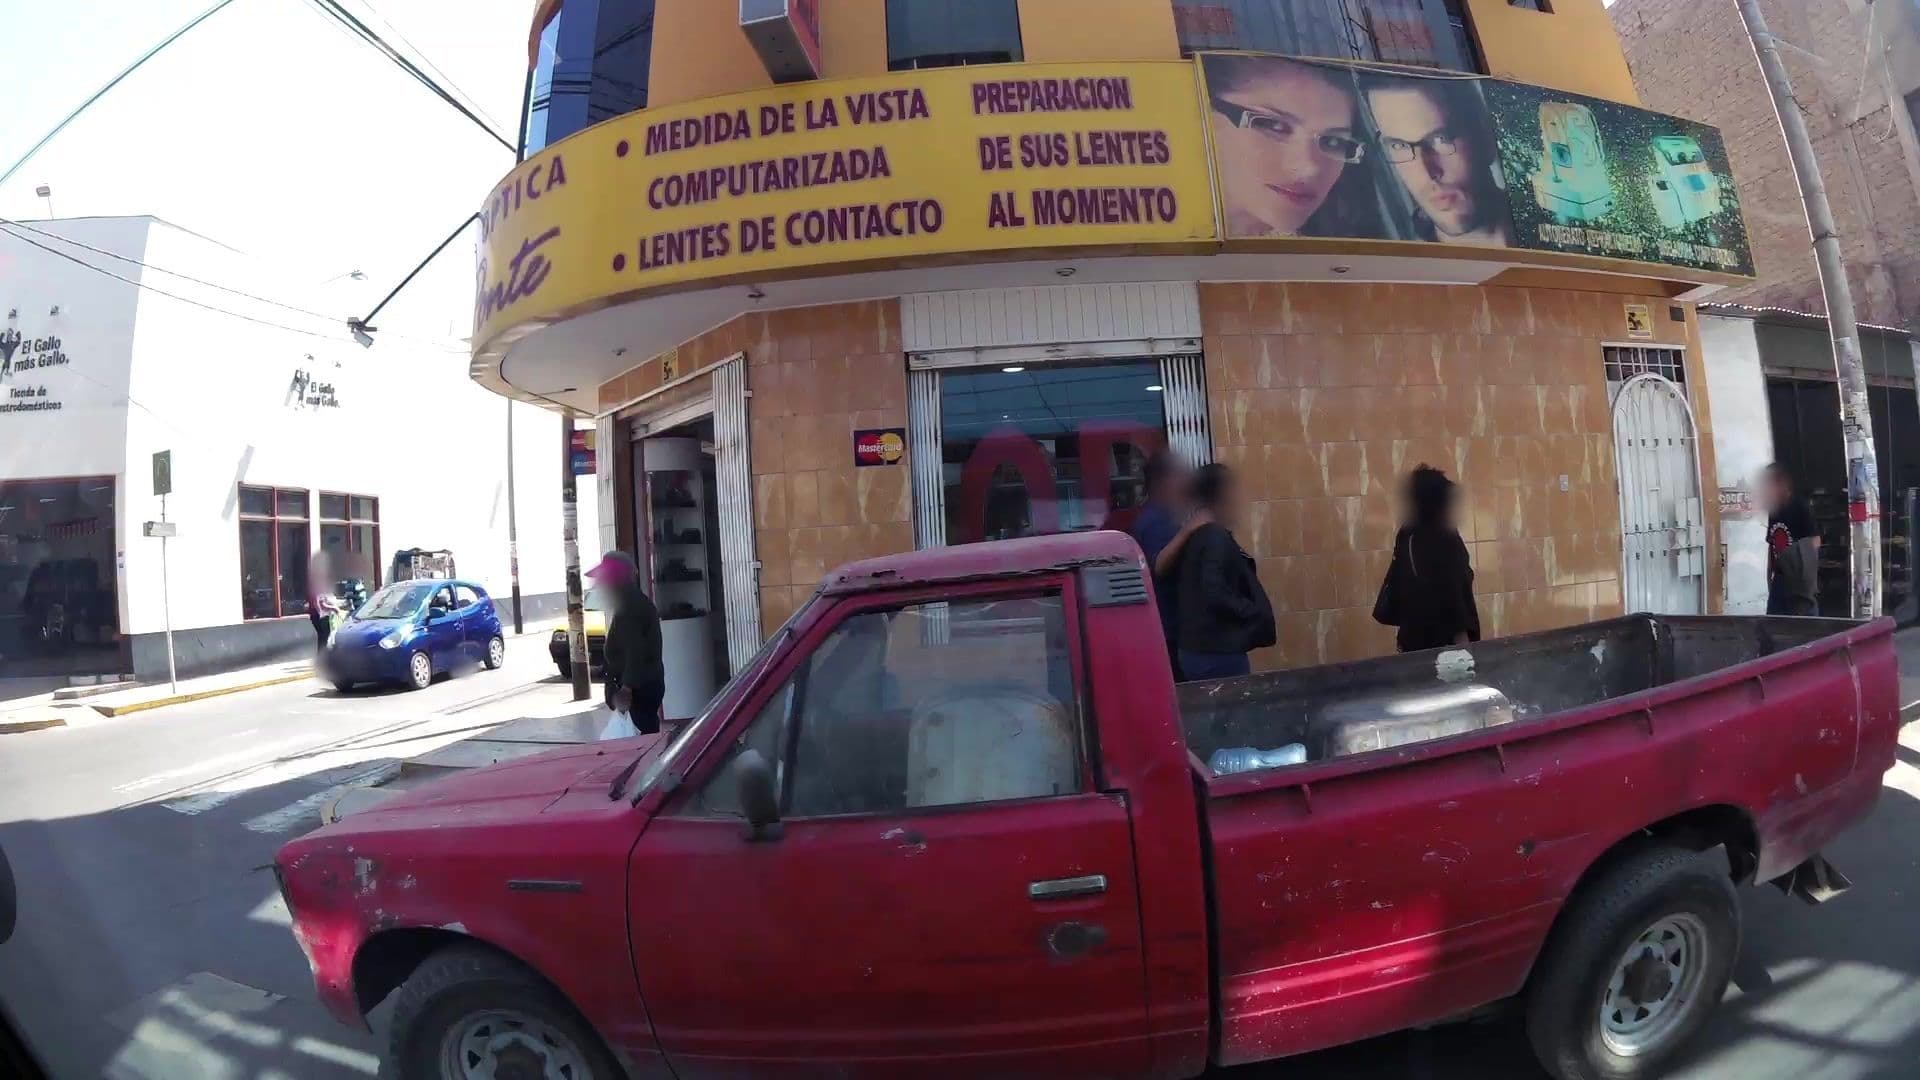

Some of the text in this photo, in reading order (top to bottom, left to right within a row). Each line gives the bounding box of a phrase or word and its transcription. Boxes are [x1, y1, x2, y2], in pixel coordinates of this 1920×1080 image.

[971, 77, 1132, 115] PREPARACION
[644, 88, 929, 157] MEDIDA DE LA VISTA
[980, 131, 1170, 170] DE SUS LENTES
[648, 146, 890, 210] COMPUTARIZADA
[988, 187, 1177, 229] AL MOMENTO
[639, 199, 944, 270] LENTES DE CONTACTO
[14, 350, 70, 373] más Gallo.
[22, 336, 61, 355] El Gallo
[37, 385, 47, 397] de
